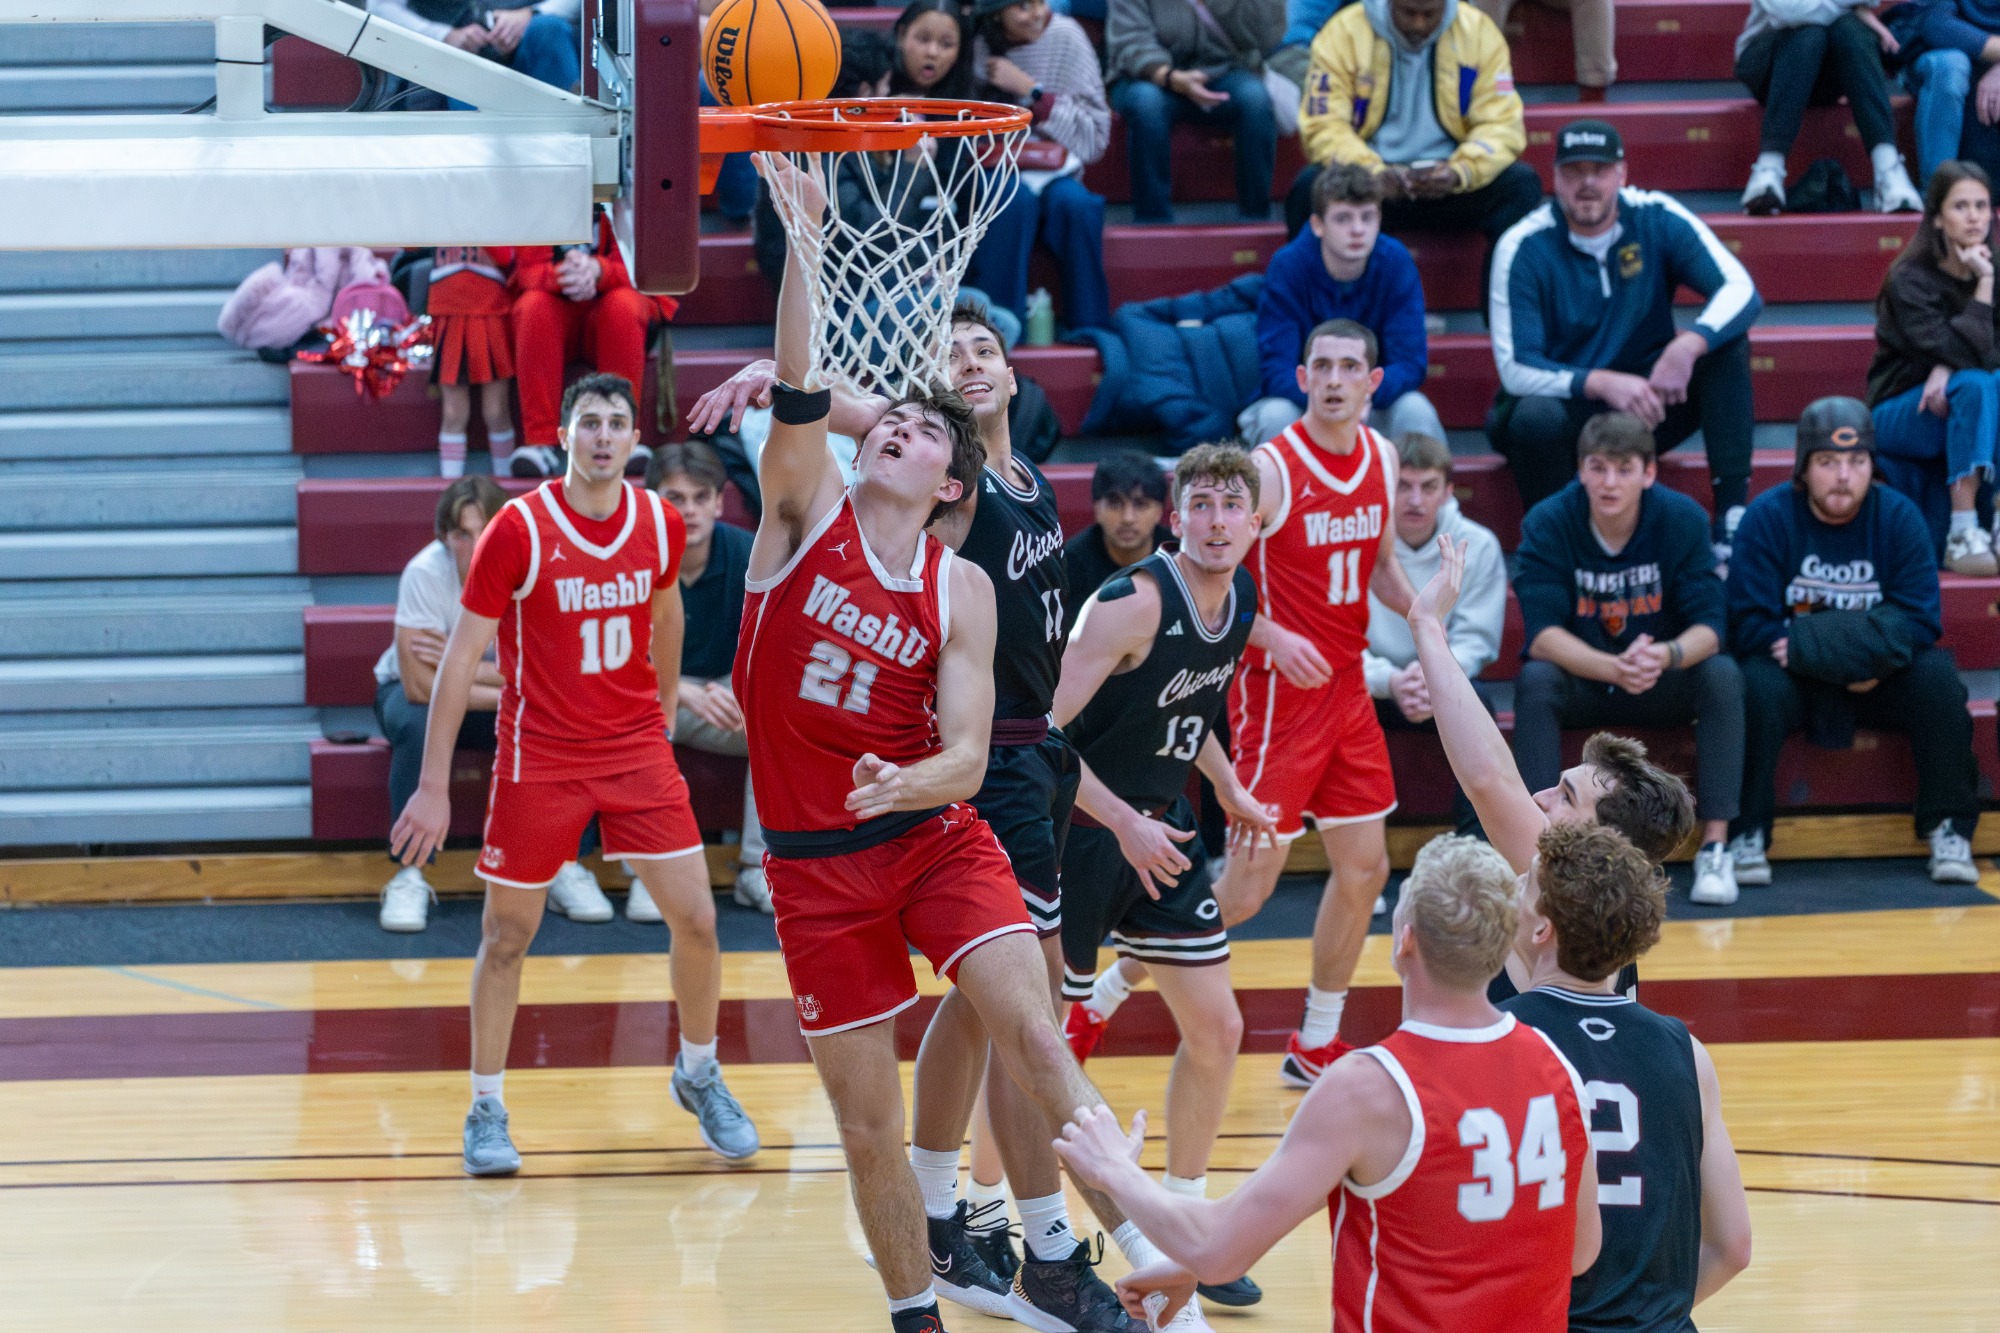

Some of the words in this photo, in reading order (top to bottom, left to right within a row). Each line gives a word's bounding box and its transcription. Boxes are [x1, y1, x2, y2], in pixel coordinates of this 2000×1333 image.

[1304, 504, 1382, 546] WashU
[554, 569, 652, 612] WashU
[1327, 548, 1361, 605] 11
[580, 615, 632, 673] 10
[802, 574, 930, 668] WashU
[799, 640, 880, 715] 21
[1155, 715, 1204, 761] 13
[1457, 1094, 1567, 1222] 34
[1584, 1080, 1642, 1205] 2
